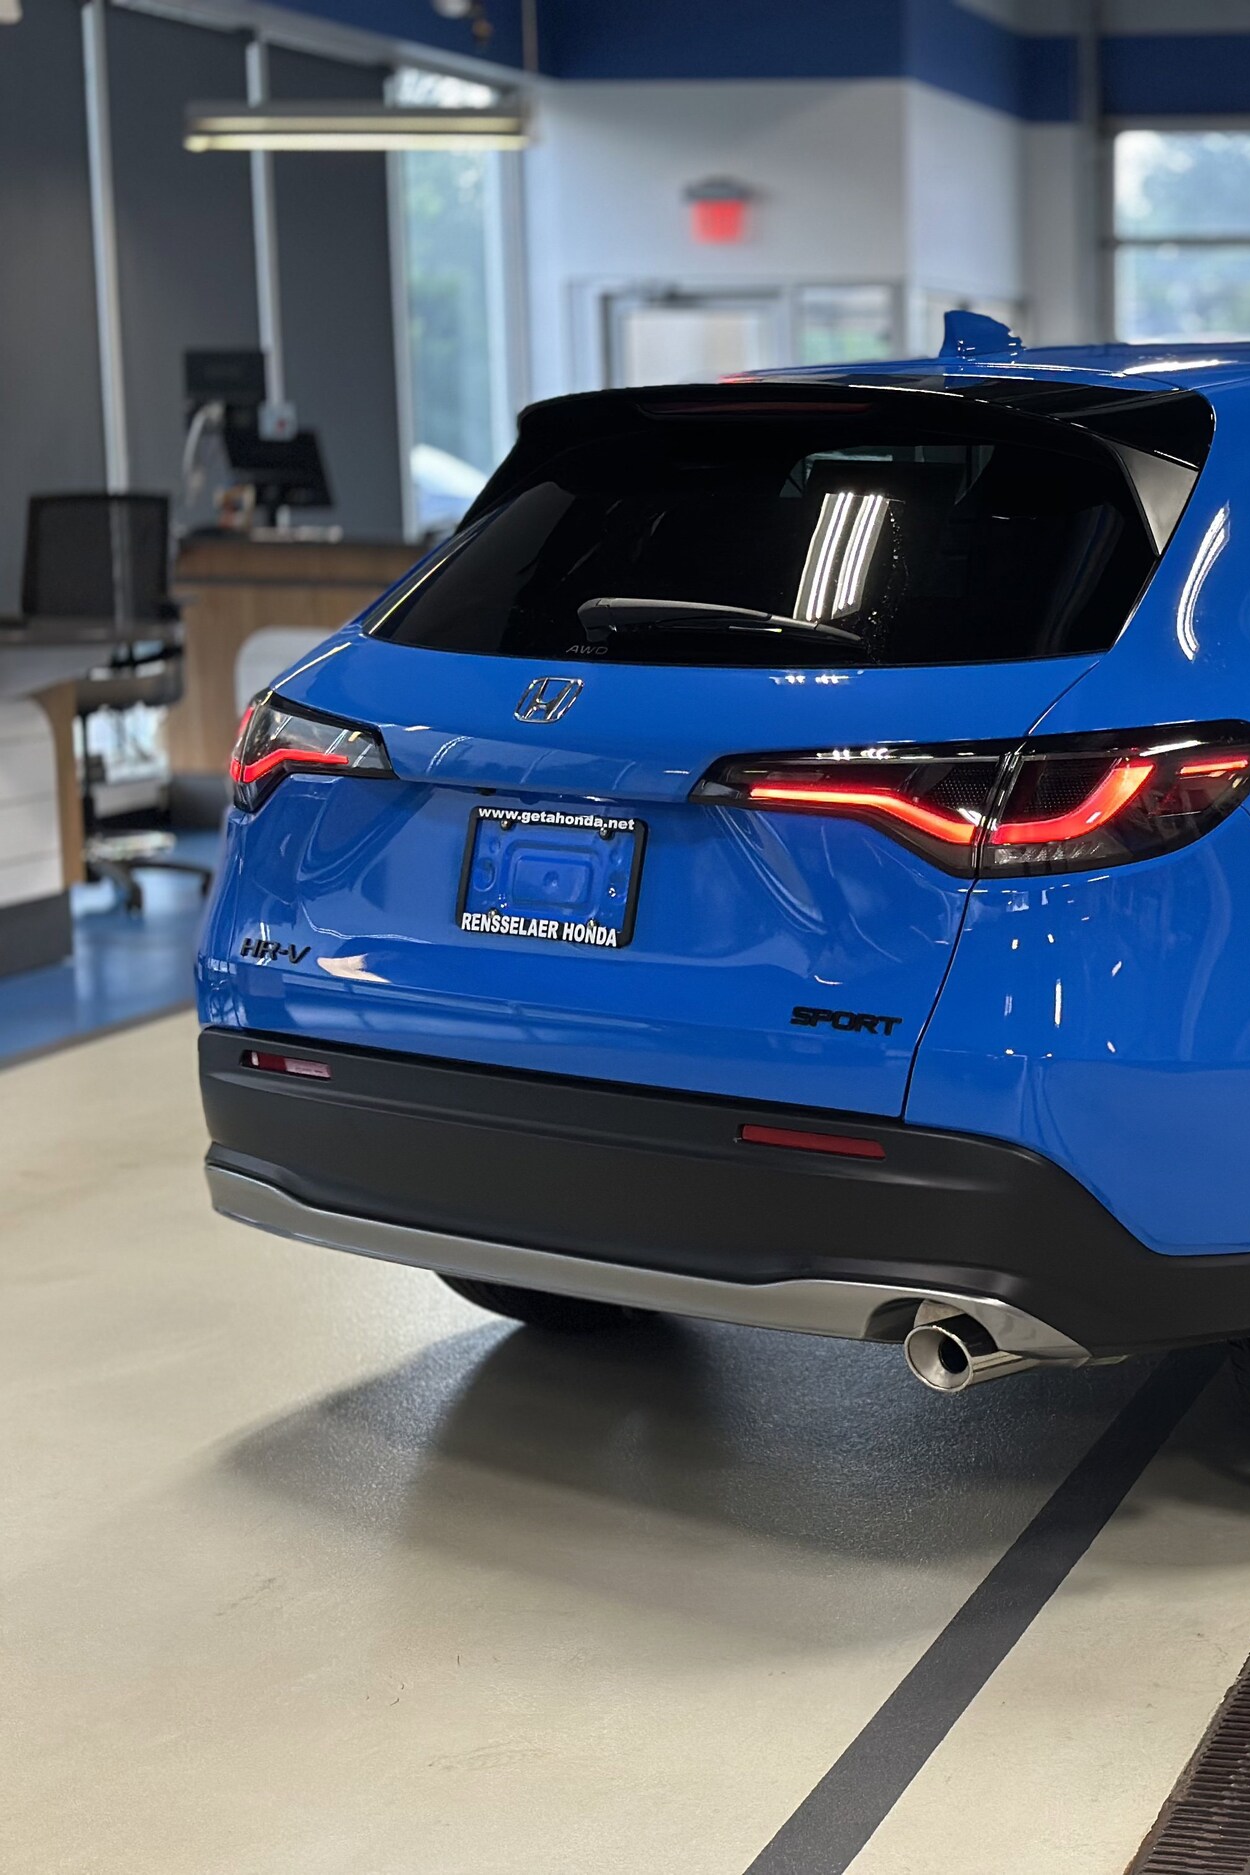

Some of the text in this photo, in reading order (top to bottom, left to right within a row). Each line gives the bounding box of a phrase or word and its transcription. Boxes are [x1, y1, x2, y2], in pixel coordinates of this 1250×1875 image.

[566, 644, 609, 655] AWD
[478, 807, 635, 831] www.getahonda.net
[461, 912, 618, 948] RENSSELAER HONDA
[240, 937, 312, 965] HR-V
[789, 1006, 904, 1037] SPORT
